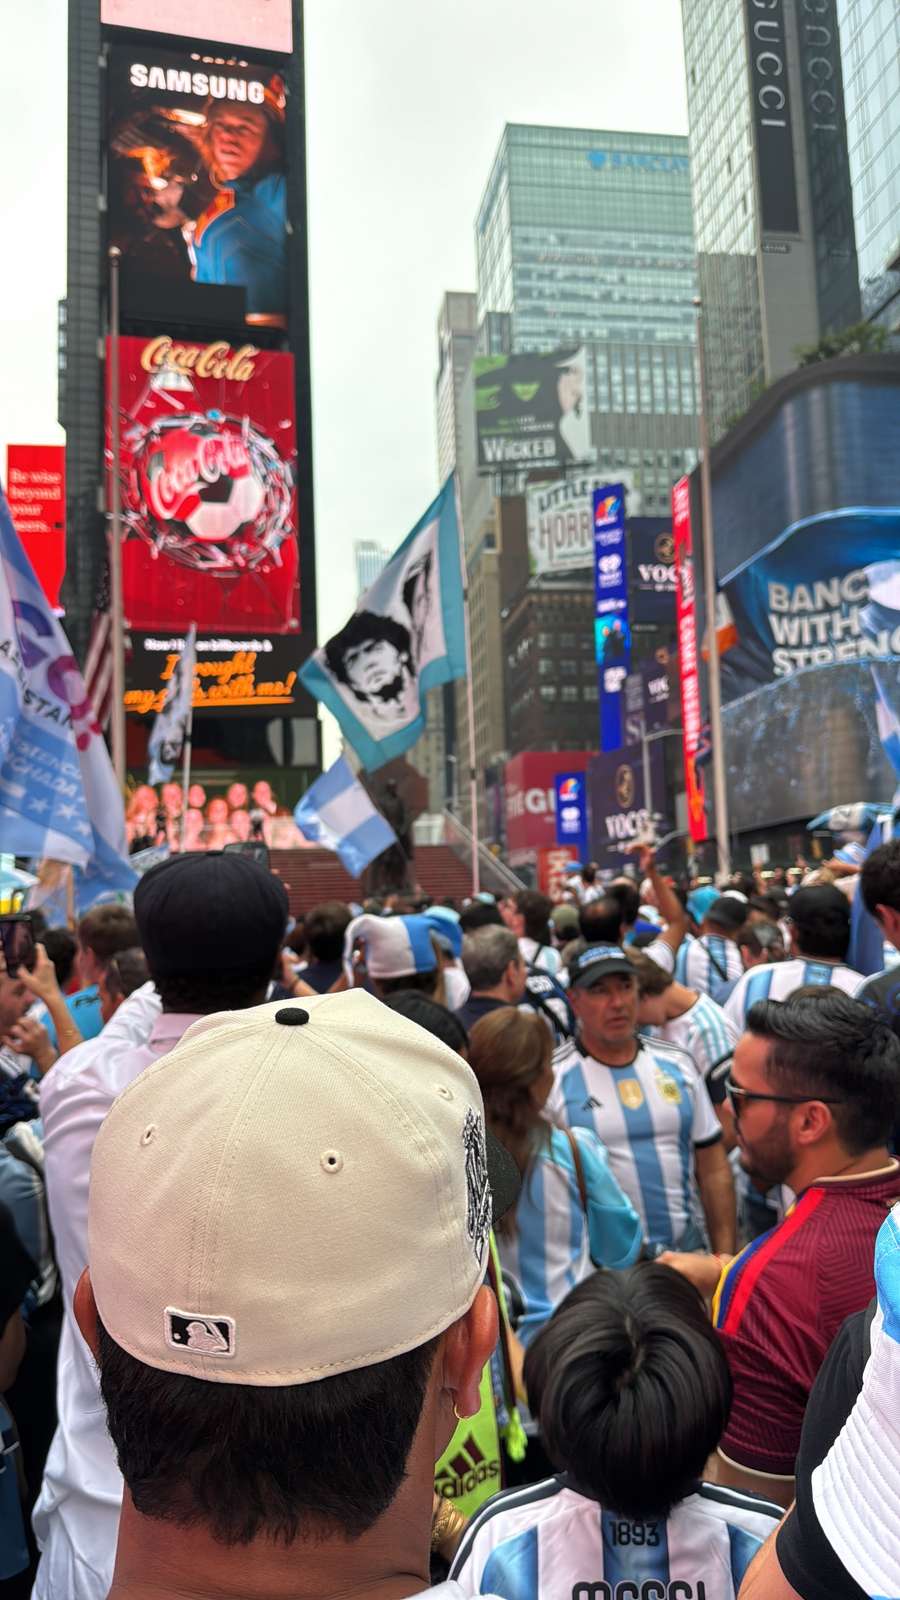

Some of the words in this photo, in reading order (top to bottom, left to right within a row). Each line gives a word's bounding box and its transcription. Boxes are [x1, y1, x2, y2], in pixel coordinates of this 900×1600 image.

[130, 63, 265, 104] SAMSUNG
[540, 510, 593, 551] HORR
[768, 605, 860, 647] WITH
[609, 1521, 661, 1547] 1893
